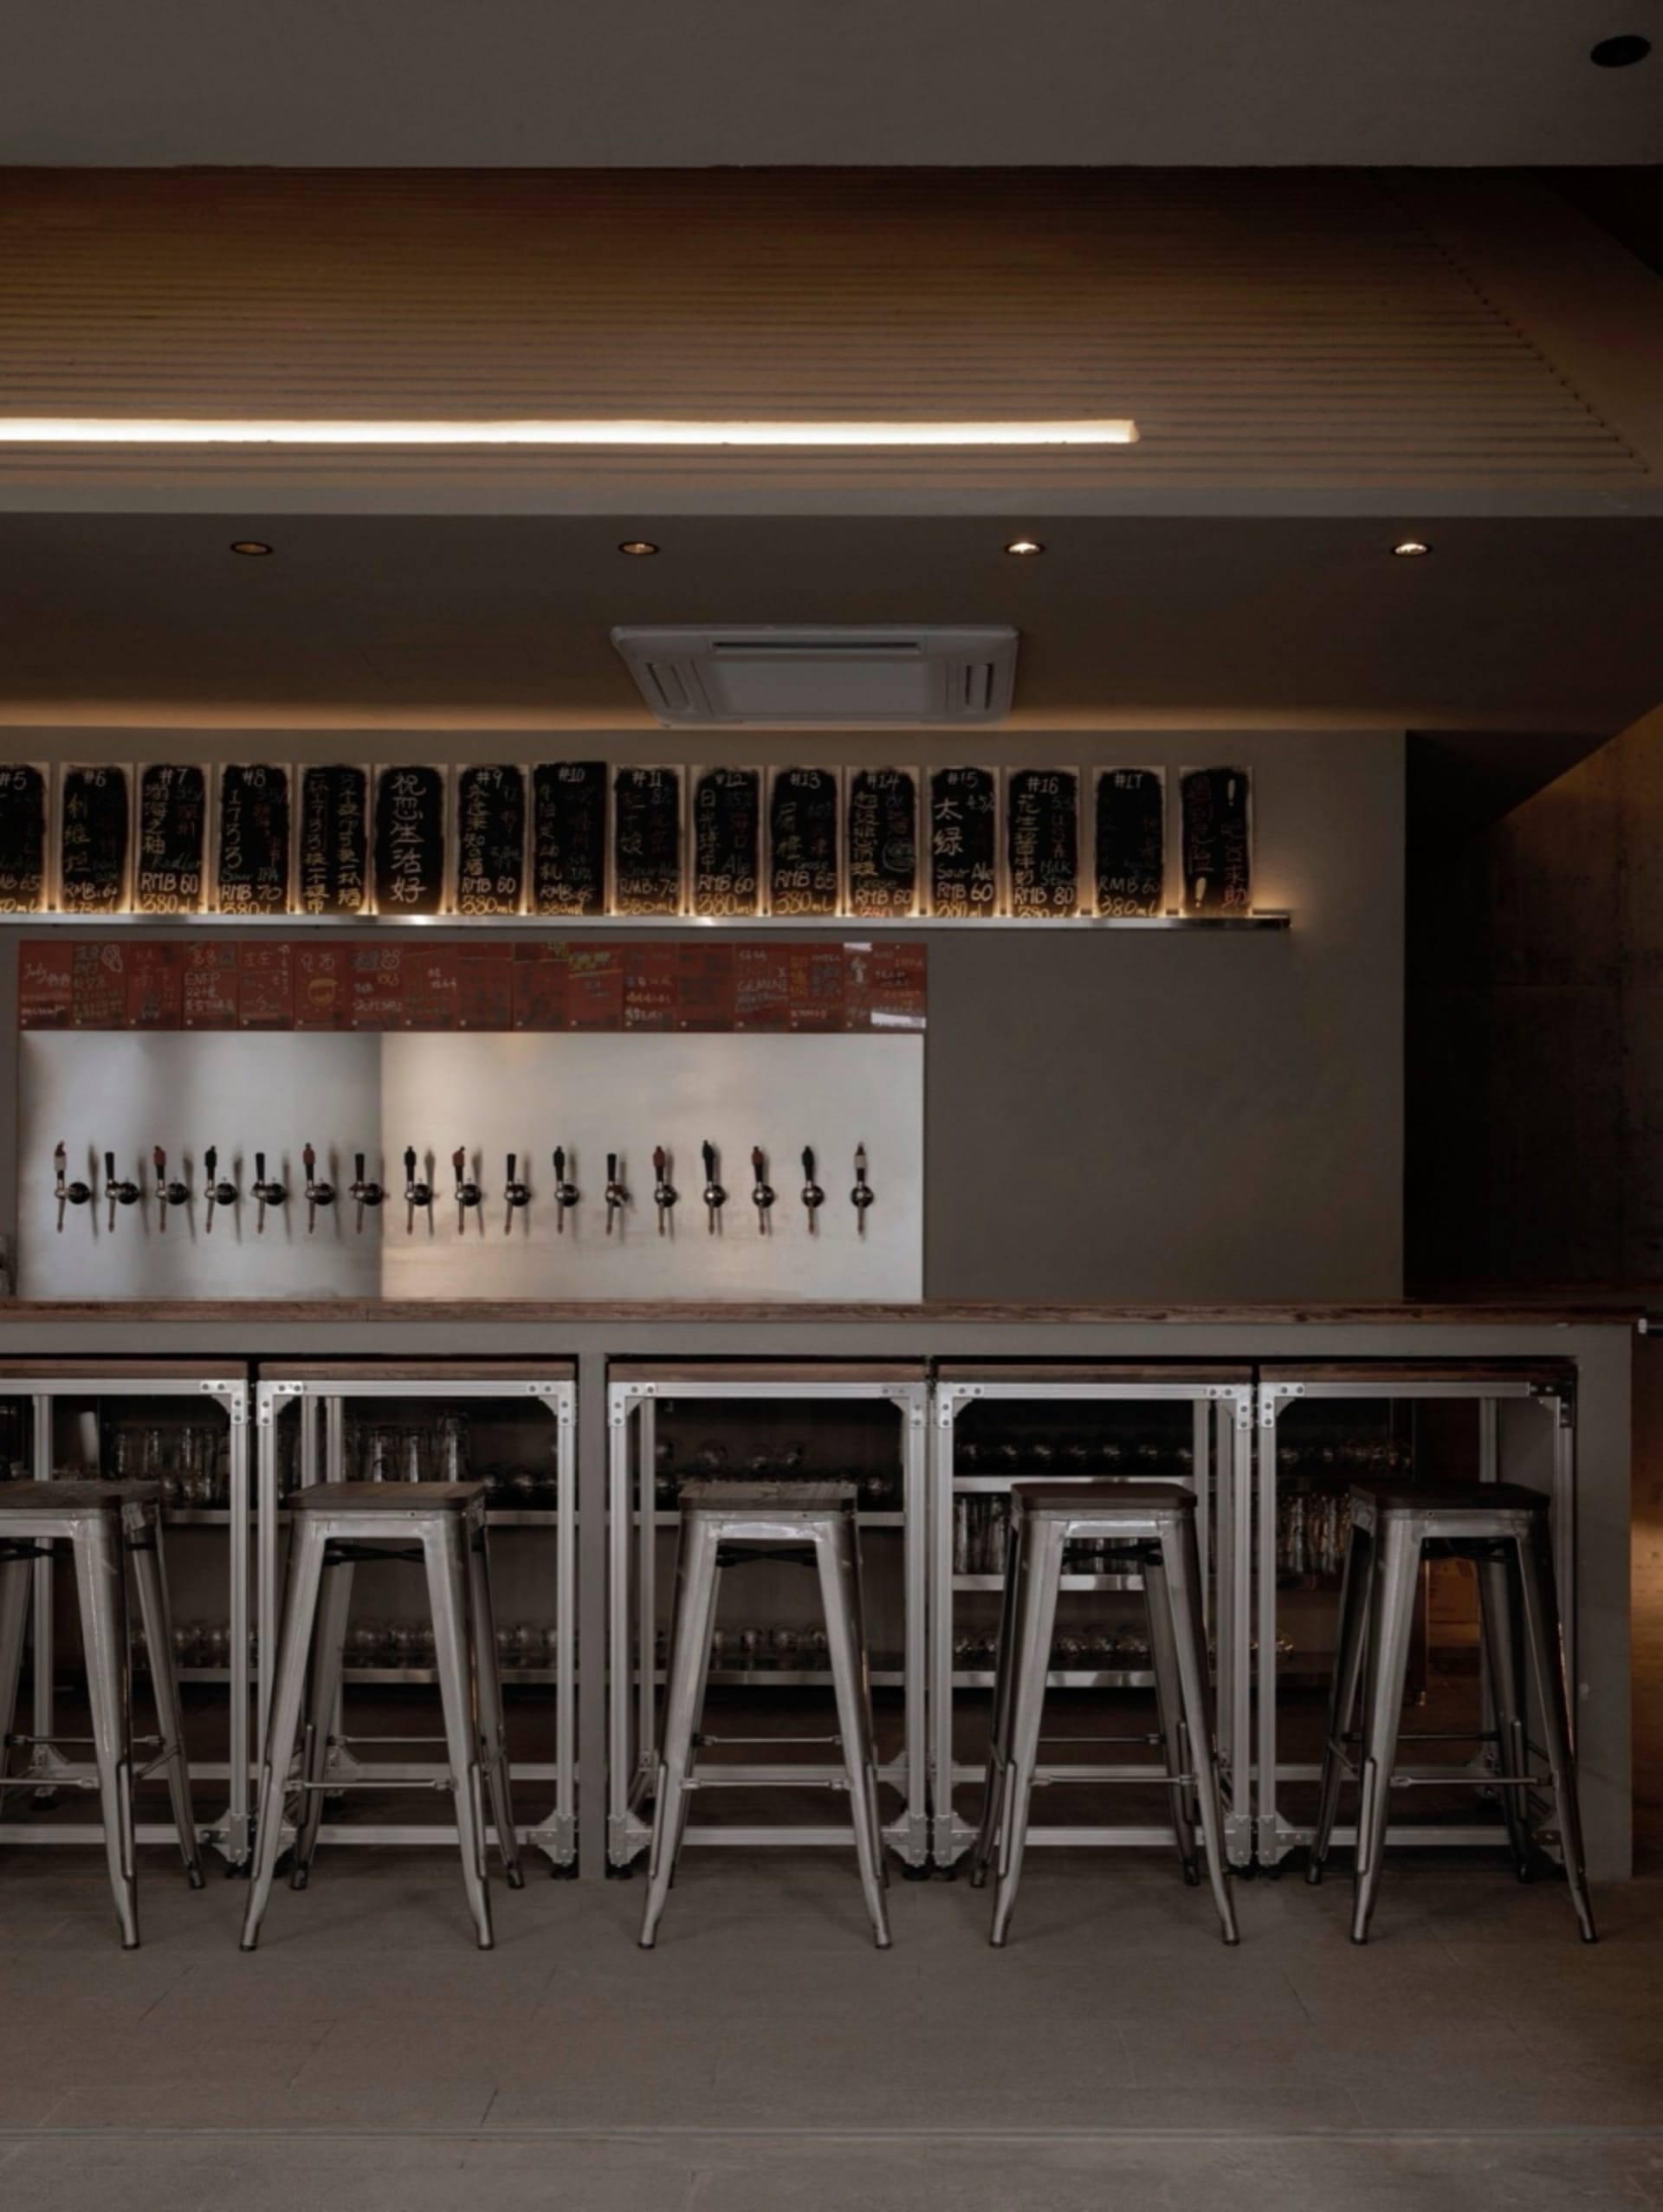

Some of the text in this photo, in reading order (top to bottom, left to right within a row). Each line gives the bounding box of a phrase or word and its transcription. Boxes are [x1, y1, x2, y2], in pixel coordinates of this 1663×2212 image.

[84, 769, 107, 787] #6
[160, 769, 188, 785] #7
[476, 769, 504, 789] #9
[946, 770, 978, 789] #15
[1026, 775, 1060, 795] #16
[389, 771, 428, 903] 祝您生活好
[141, 872, 198, 895] RMB 60
[461, 876, 518, 895] RMB 60
[698, 873, 754, 895] RMB 60
[775, 870, 836, 890] RMB 65
[1099, 875, 1138, 894] RMB
[221, 883, 283, 902] RMB 70
[854, 889, 889, 906] RMB
[935, 881, 993, 902] RMB 60
[1013, 885, 1075, 906] RMB 80
